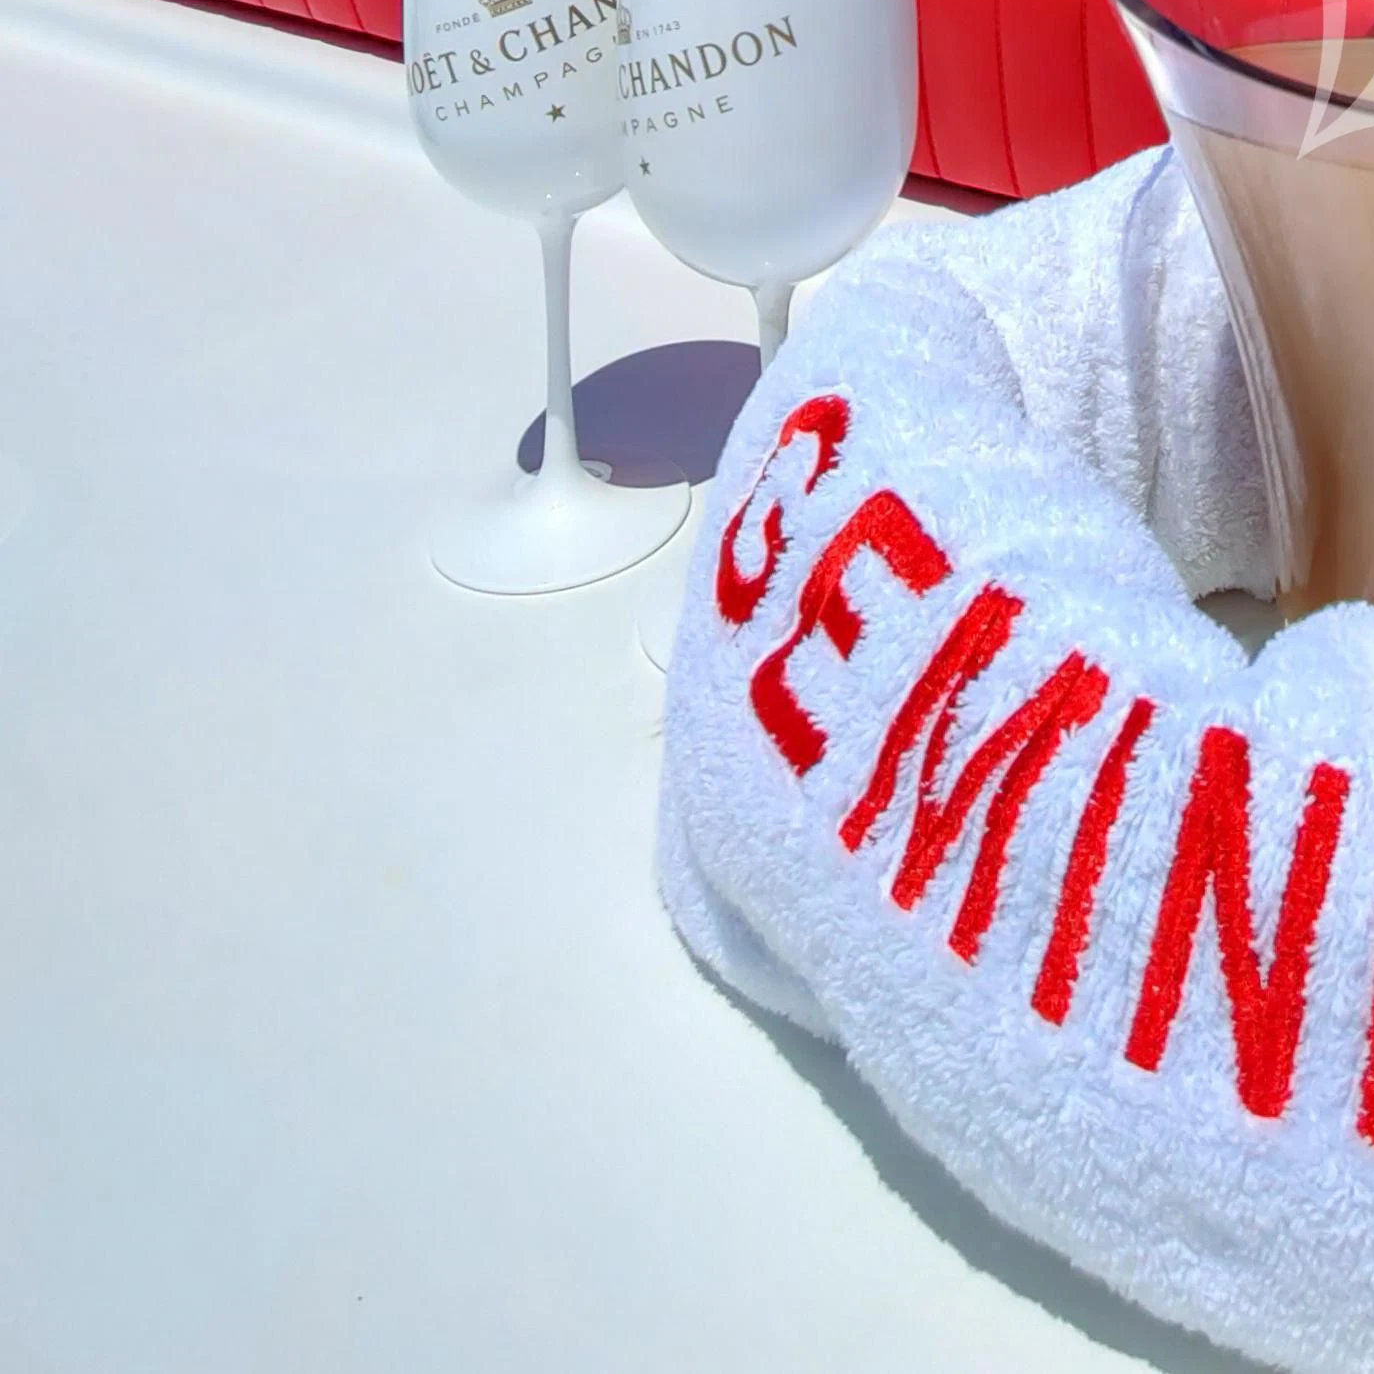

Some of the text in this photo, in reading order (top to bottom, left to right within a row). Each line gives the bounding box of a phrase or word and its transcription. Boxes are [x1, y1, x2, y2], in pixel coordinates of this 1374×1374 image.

[618, 14, 798, 100] CHANDON
[635, 20, 681, 41] EN 1743
[435, 35, 616, 122] CHAMPAG
[469, 49, 497, 76] &
